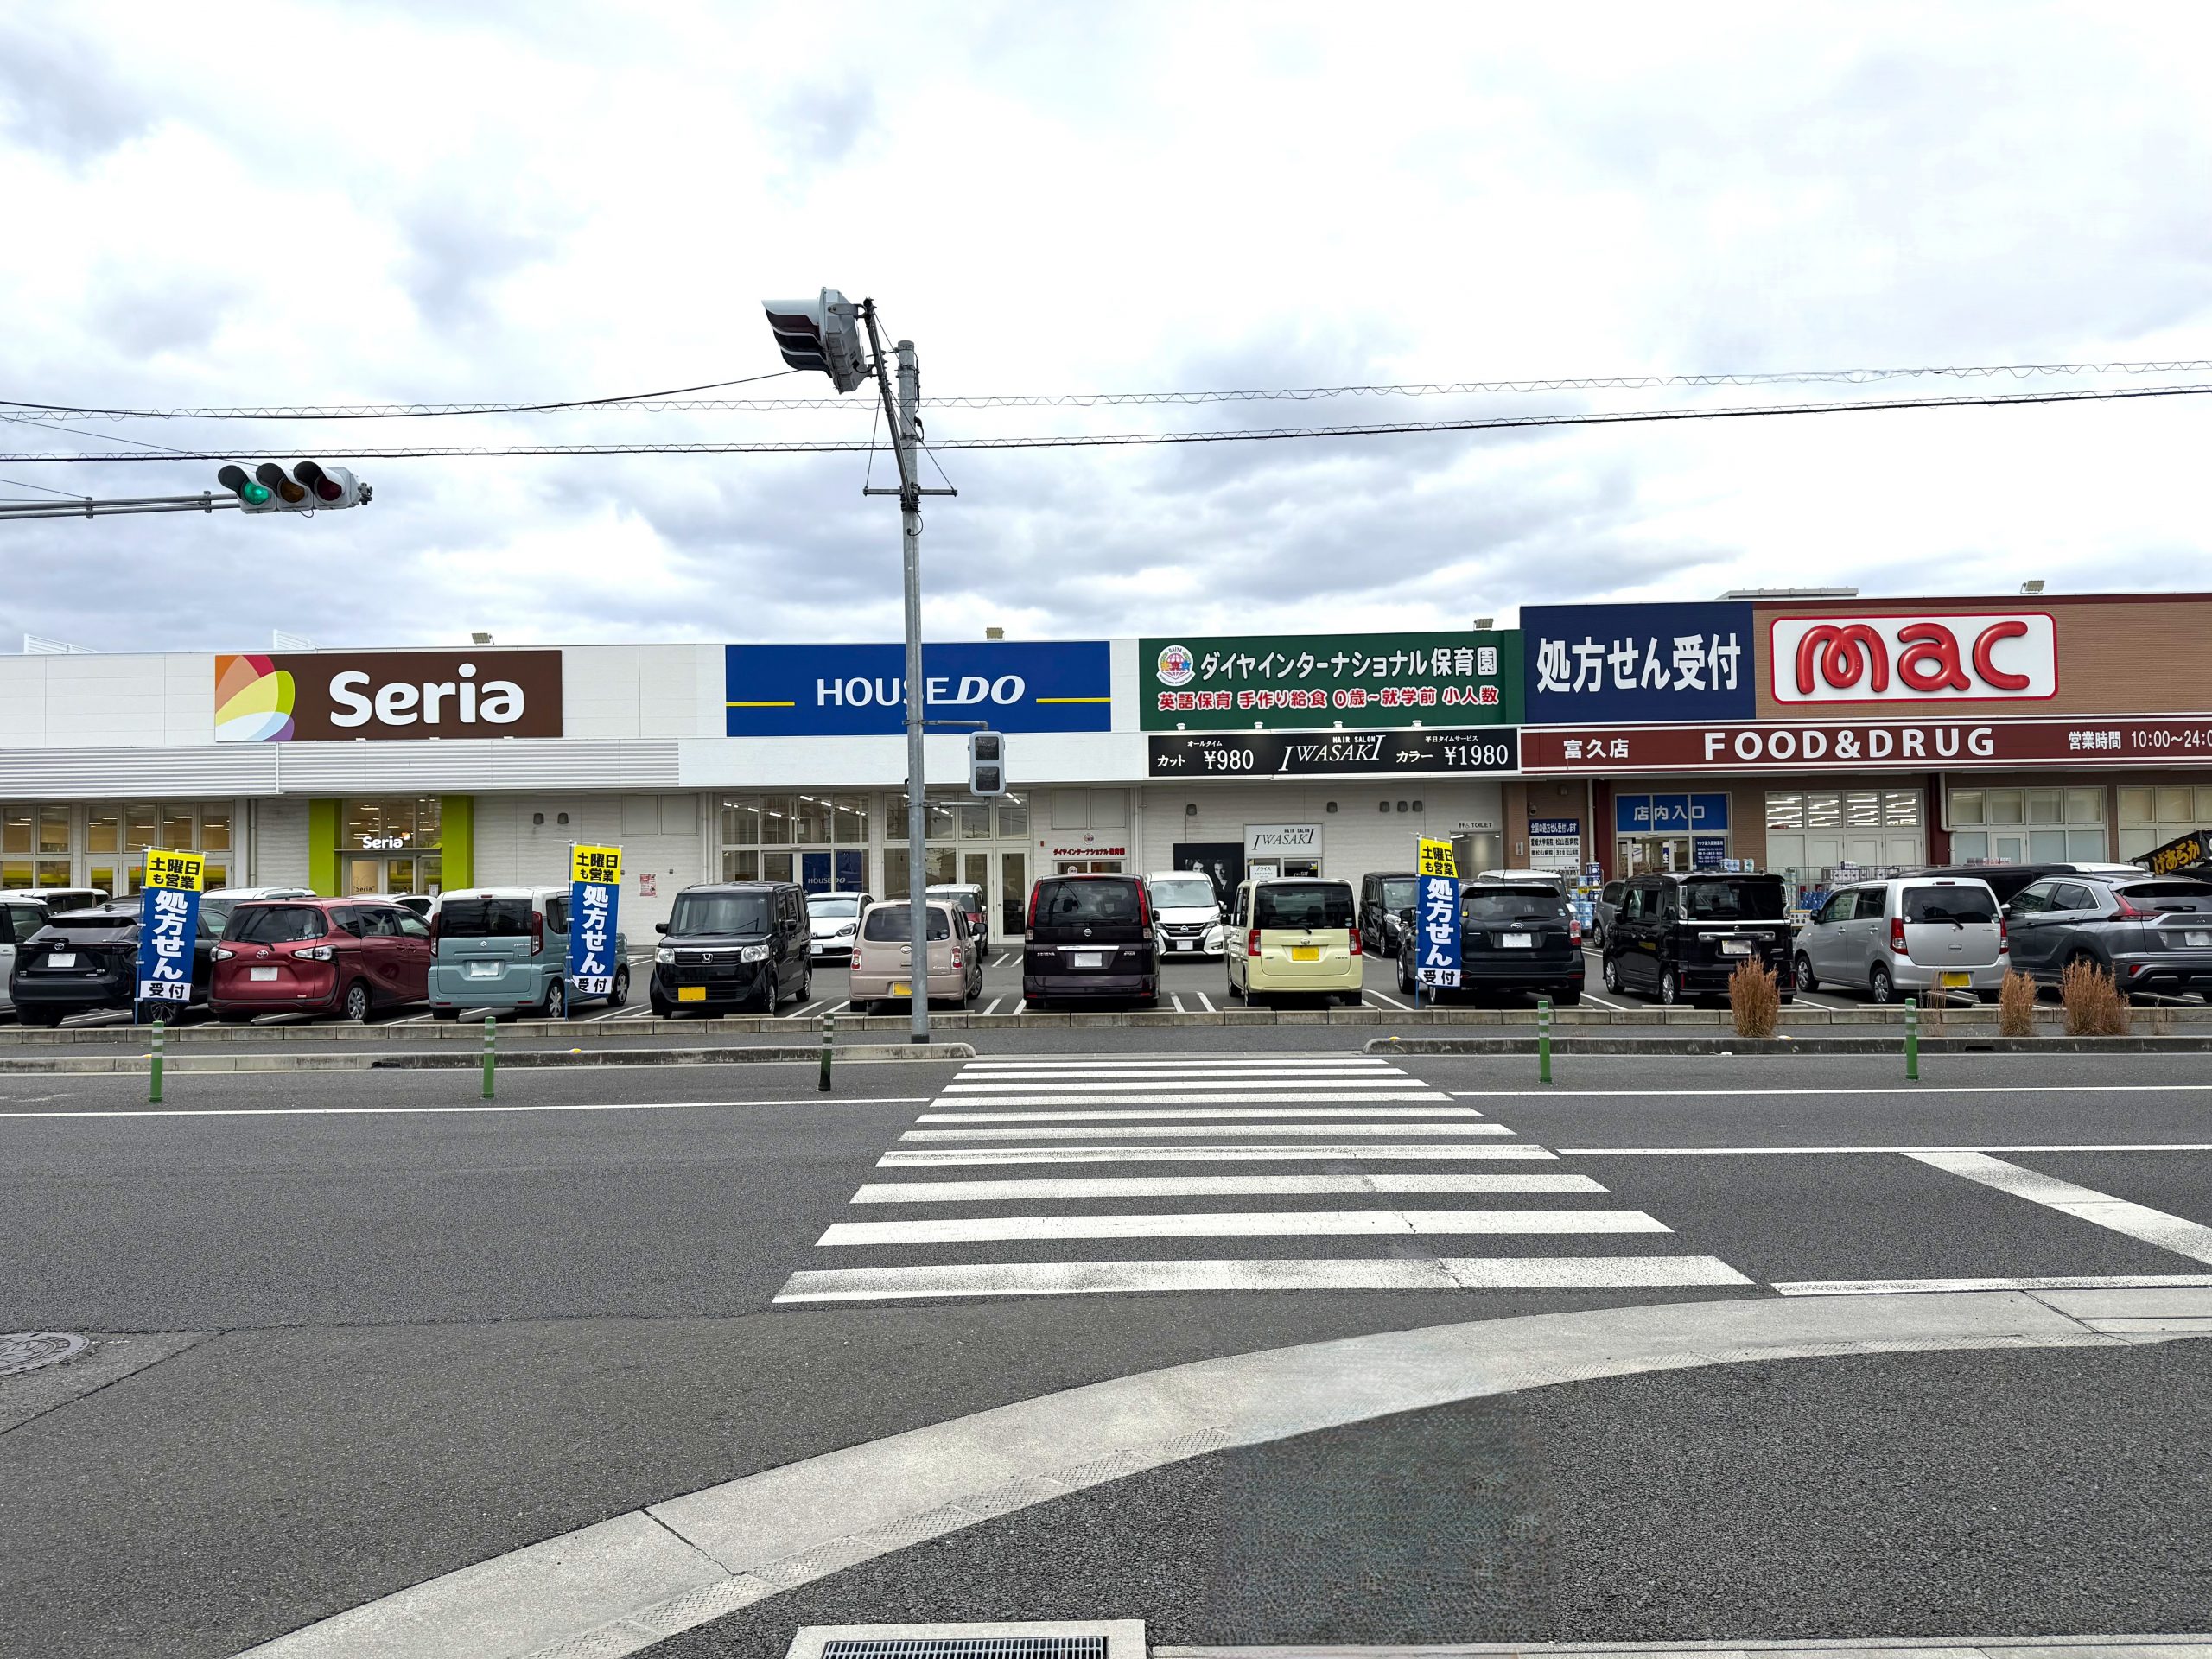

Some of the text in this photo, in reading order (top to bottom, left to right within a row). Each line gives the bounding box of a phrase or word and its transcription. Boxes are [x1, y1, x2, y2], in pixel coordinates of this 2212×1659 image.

[1536, 632, 1741, 694] 処方せん受付
[1796, 621, 2031, 694] mac
[329, 663, 525, 727] Seria
[1158, 690, 1232, 710] 英語保育
[1238, 689, 1327, 709] 手作り給食
[1442, 685, 1499, 705] 小人数
[1563, 738, 1630, 759] 富久店
[1704, 728, 1994, 760] FOOD&DRUG
[2069, 731, 2121, 750] 営業時間
[1157, 749, 1254, 770] カット ¥980
[1278, 735, 1386, 772] IWASAKI
[1396, 744, 1508, 766] カラー ¥1980
[1634, 805, 1705, 821] 店内入口
[362, 836, 404, 849] Seria
[1251, 829, 1316, 850] IWASAKI
[576, 852, 619, 869] 土曜日
[1421, 845, 1453, 862] 土曜日
[149, 857, 200, 875] 土曜日
[580, 868, 614, 883] も営業
[1425, 861, 1454, 876] も営業
[152, 873, 195, 890] も営業
[580, 885, 609, 975] 処方せん
[1425, 878, 1454, 967] 処方せん
[151, 890, 188, 980] 処方せん
[578, 977, 607, 993] 受付
[1423, 969, 1455, 985] 受付
[149, 982, 185, 999] 受付
